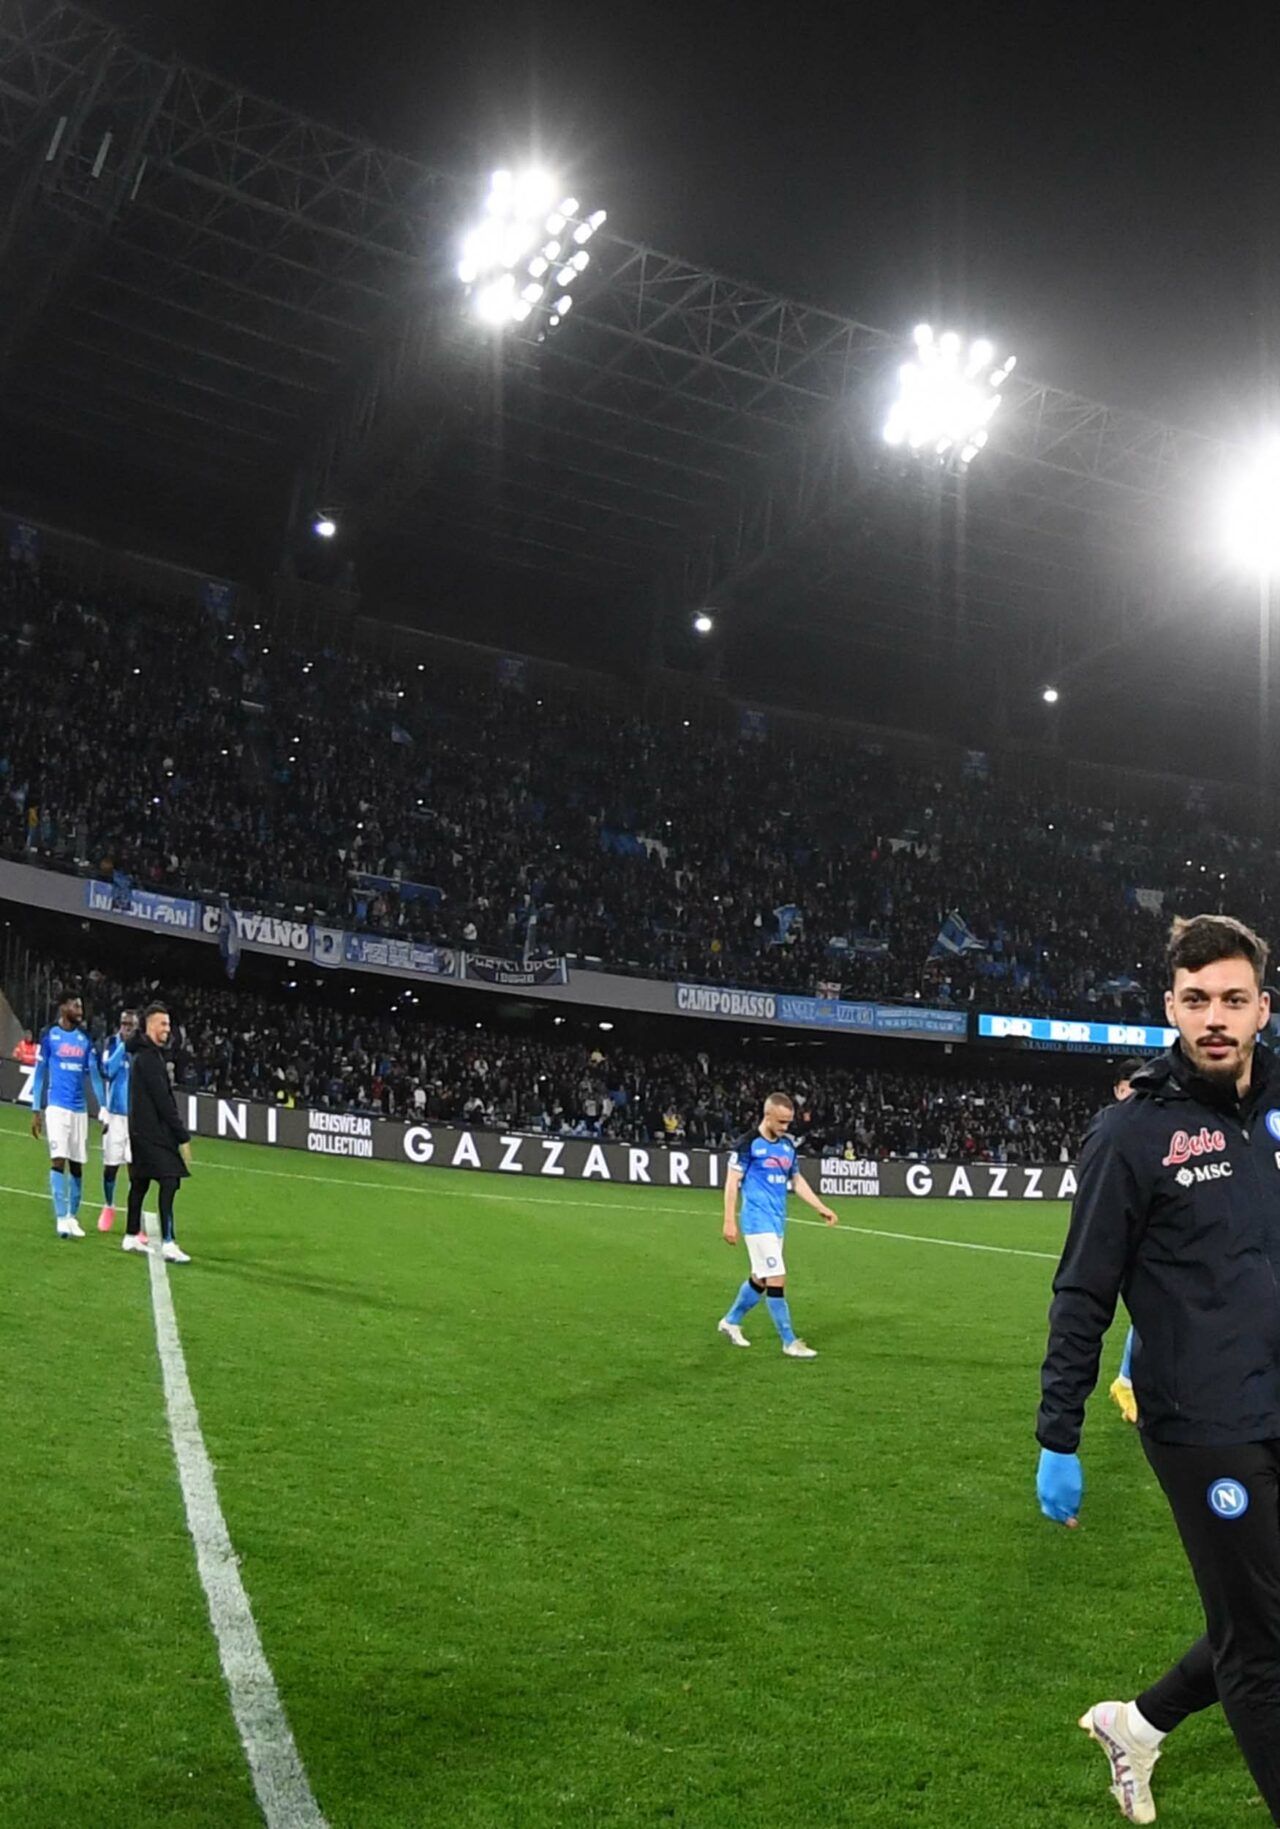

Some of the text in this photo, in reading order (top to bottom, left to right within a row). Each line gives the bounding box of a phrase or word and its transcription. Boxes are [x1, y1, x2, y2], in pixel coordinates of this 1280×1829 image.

[203, 905, 309, 950] CIVANO
[678, 987, 775, 1018] CAMPOBASSO
[309, 1111, 372, 1137] MENSWEAR
[307, 1133, 373, 1158] COLLECTION
[403, 1126, 742, 1187] GAZZARRI
[1162, 1127, 1226, 1167] Lete
[820, 1158, 877, 1177] MENSWEAR
[1195, 1161, 1233, 1181] MSC
[820, 1178, 879, 1196] COLLECTION
